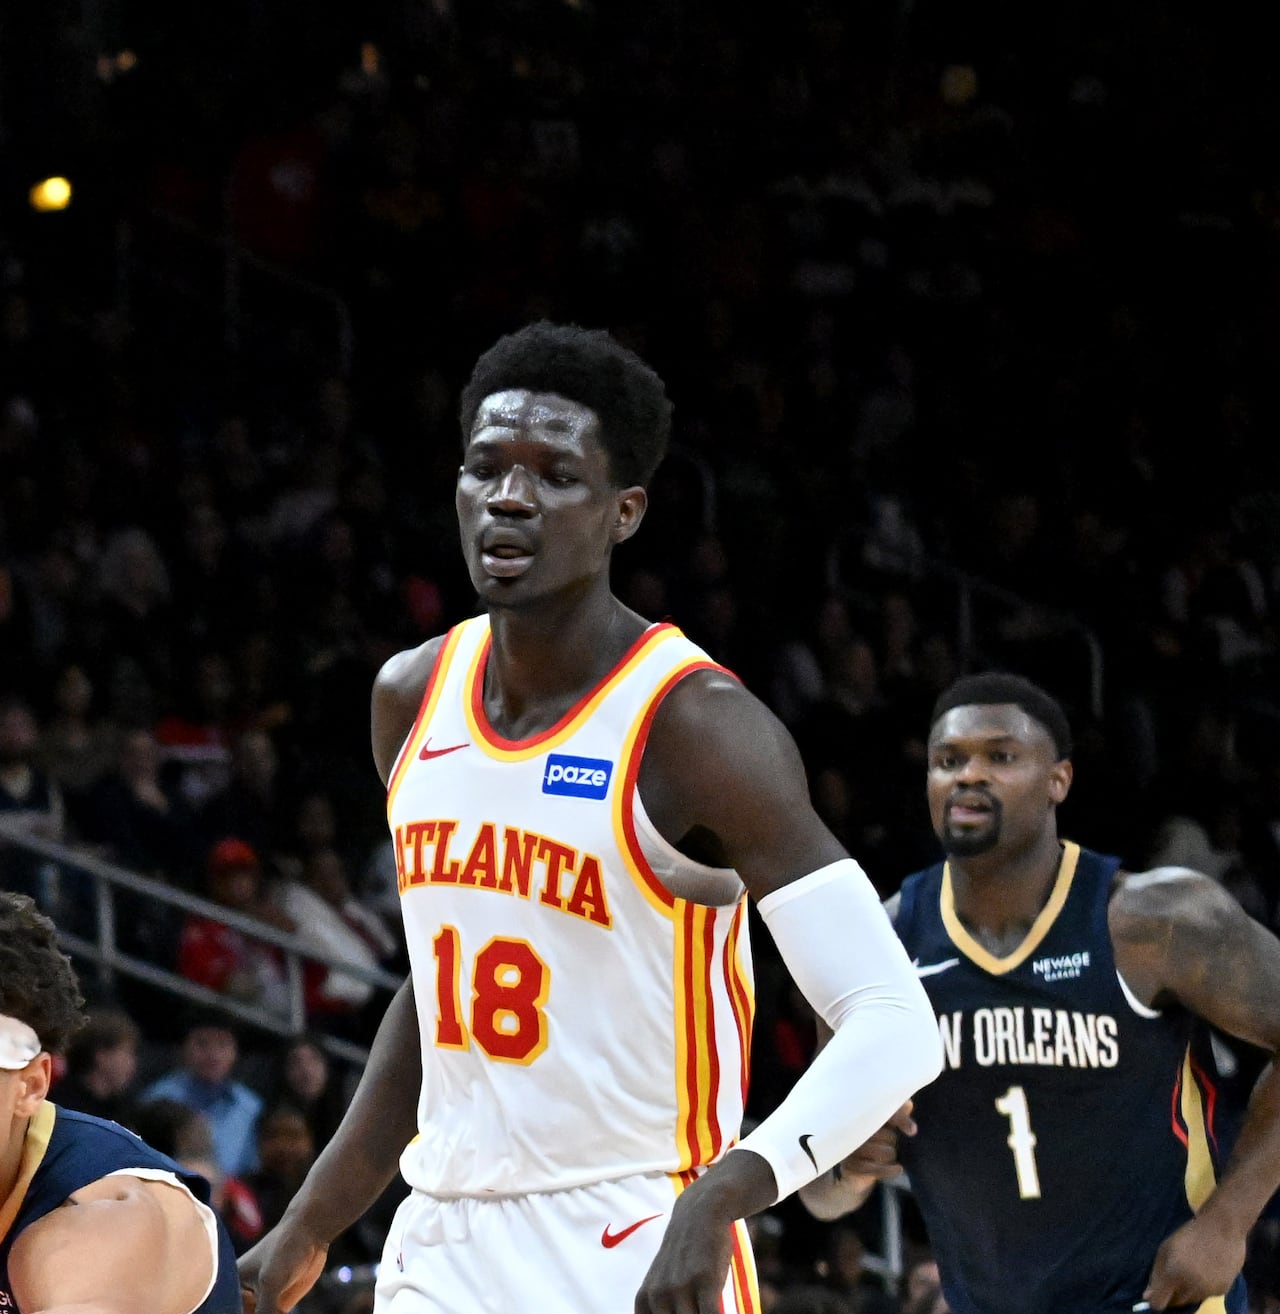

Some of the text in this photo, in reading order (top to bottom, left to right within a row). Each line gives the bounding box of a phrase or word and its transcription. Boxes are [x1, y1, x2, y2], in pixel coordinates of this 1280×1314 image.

[546, 760, 608, 787] paze
[395, 818, 613, 931] ATLANTA
[432, 923, 552, 1067] 18
[973, 1007, 1121, 1068] ORLEANS
[994, 1084, 1042, 1200] 1
